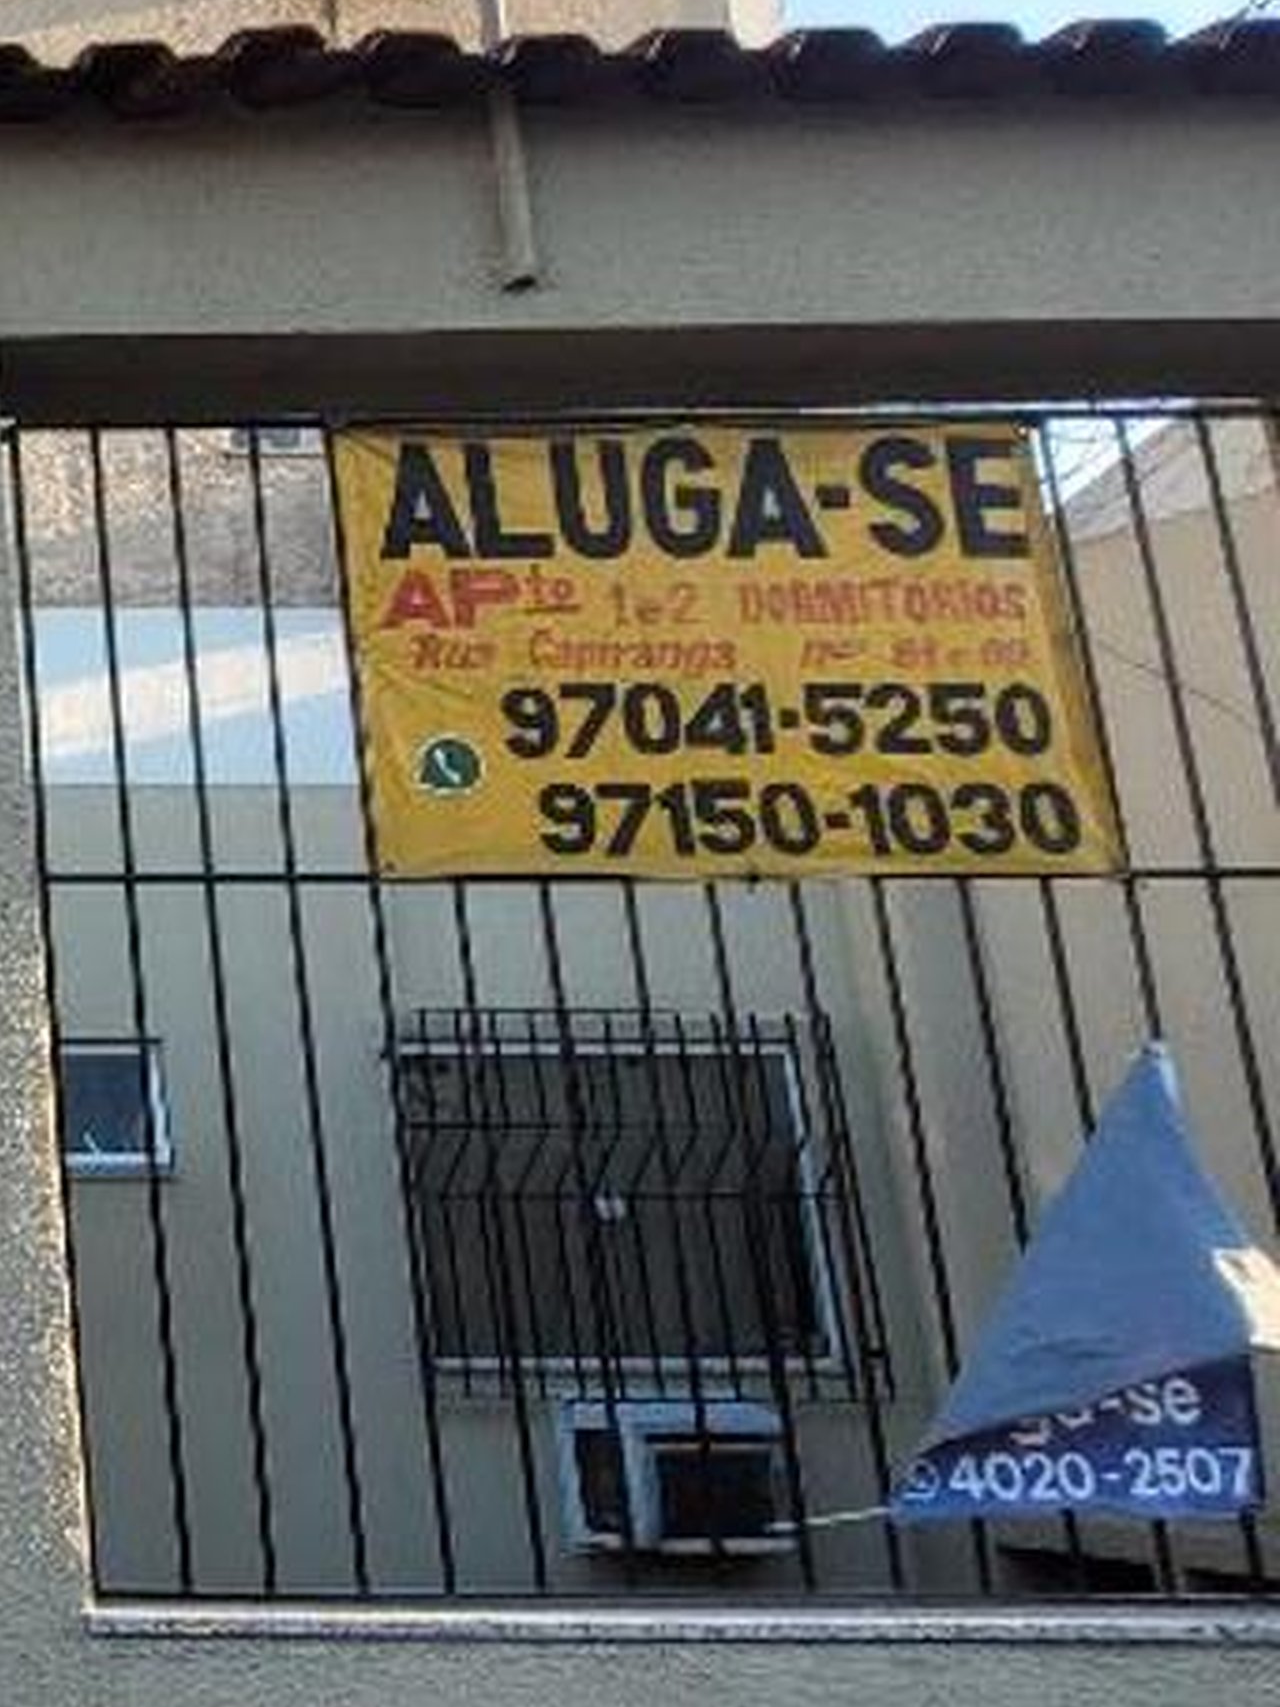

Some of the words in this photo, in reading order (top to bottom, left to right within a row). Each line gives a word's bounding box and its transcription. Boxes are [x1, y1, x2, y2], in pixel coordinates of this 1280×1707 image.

[381, 437, 1030, 559] ALUGA-SE
[501, 682, 1051, 759] 97041-5250
[540, 778, 1081, 857] 97150-1030
